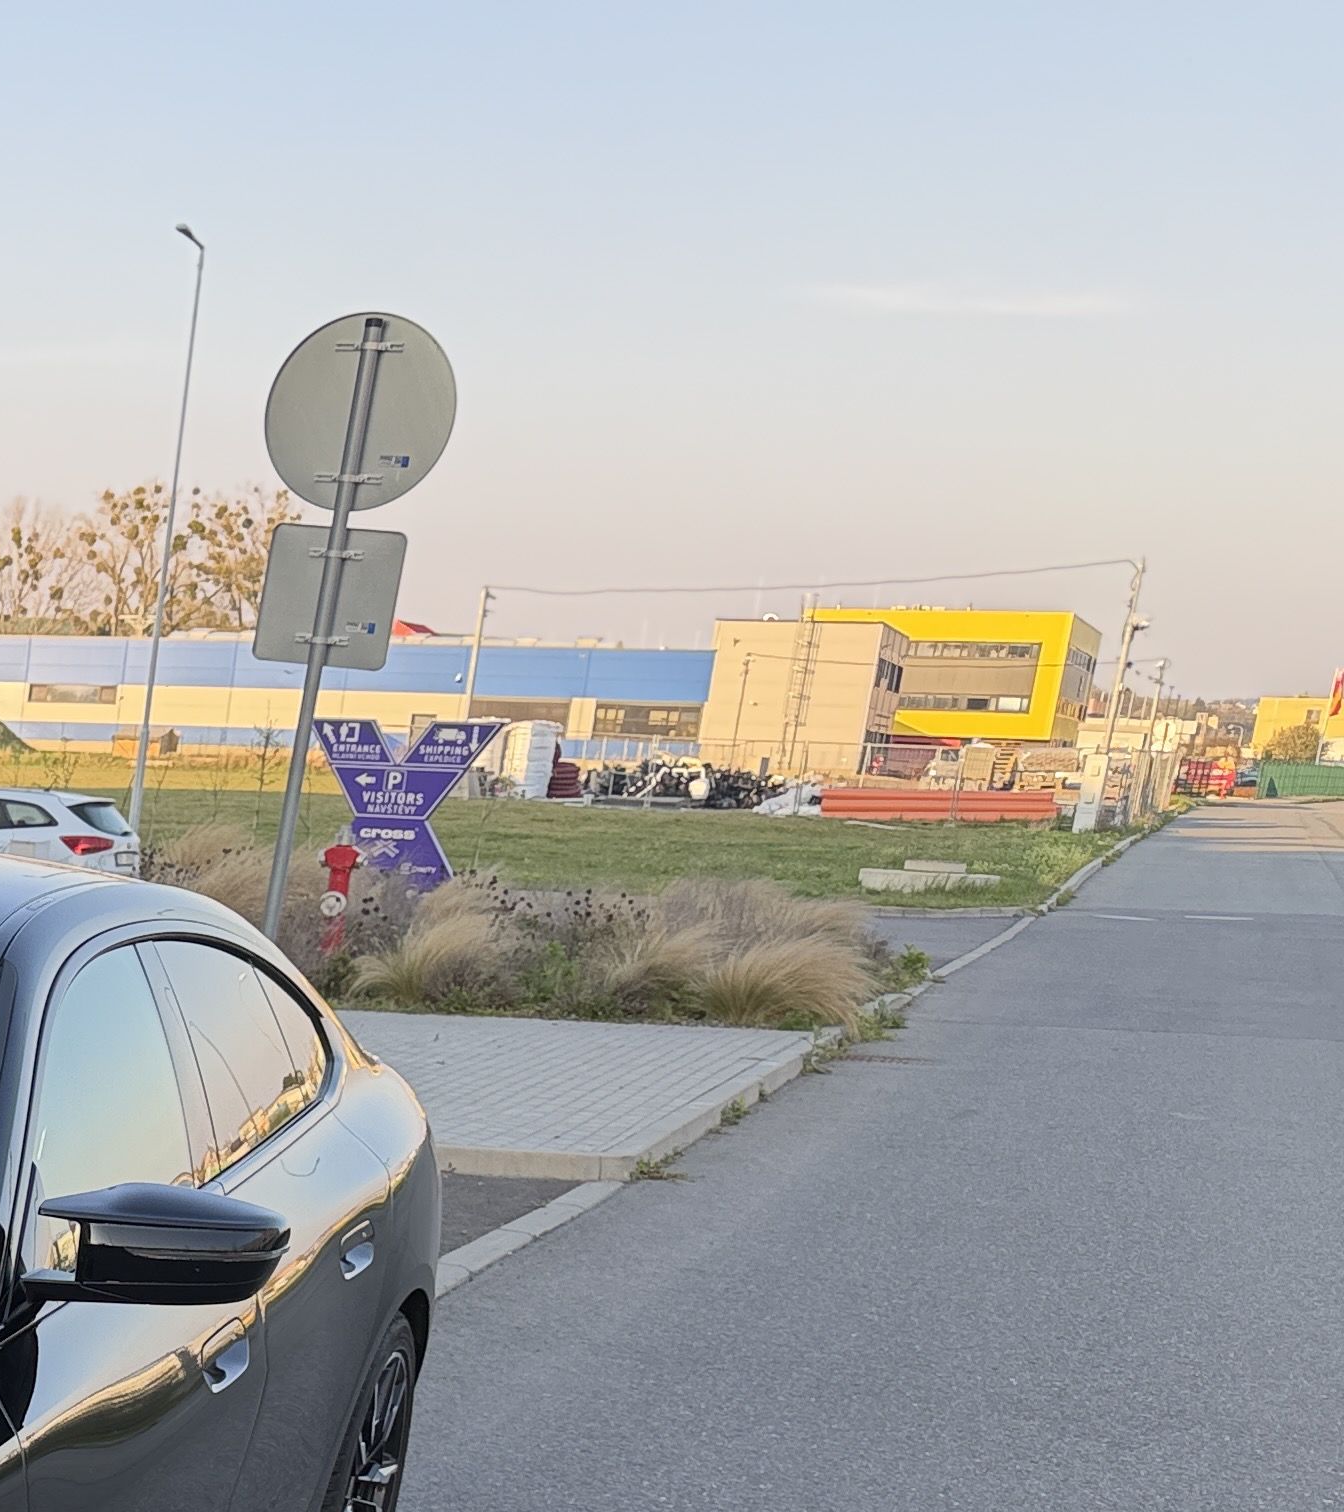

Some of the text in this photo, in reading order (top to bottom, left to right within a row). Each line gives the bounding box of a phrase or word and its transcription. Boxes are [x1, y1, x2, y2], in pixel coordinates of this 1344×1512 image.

[332, 743, 382, 754] ENTRANCE
[418, 744, 469, 756] SHIPPING
[387, 771, 403, 790] P
[362, 790, 424, 806] VISITORS
